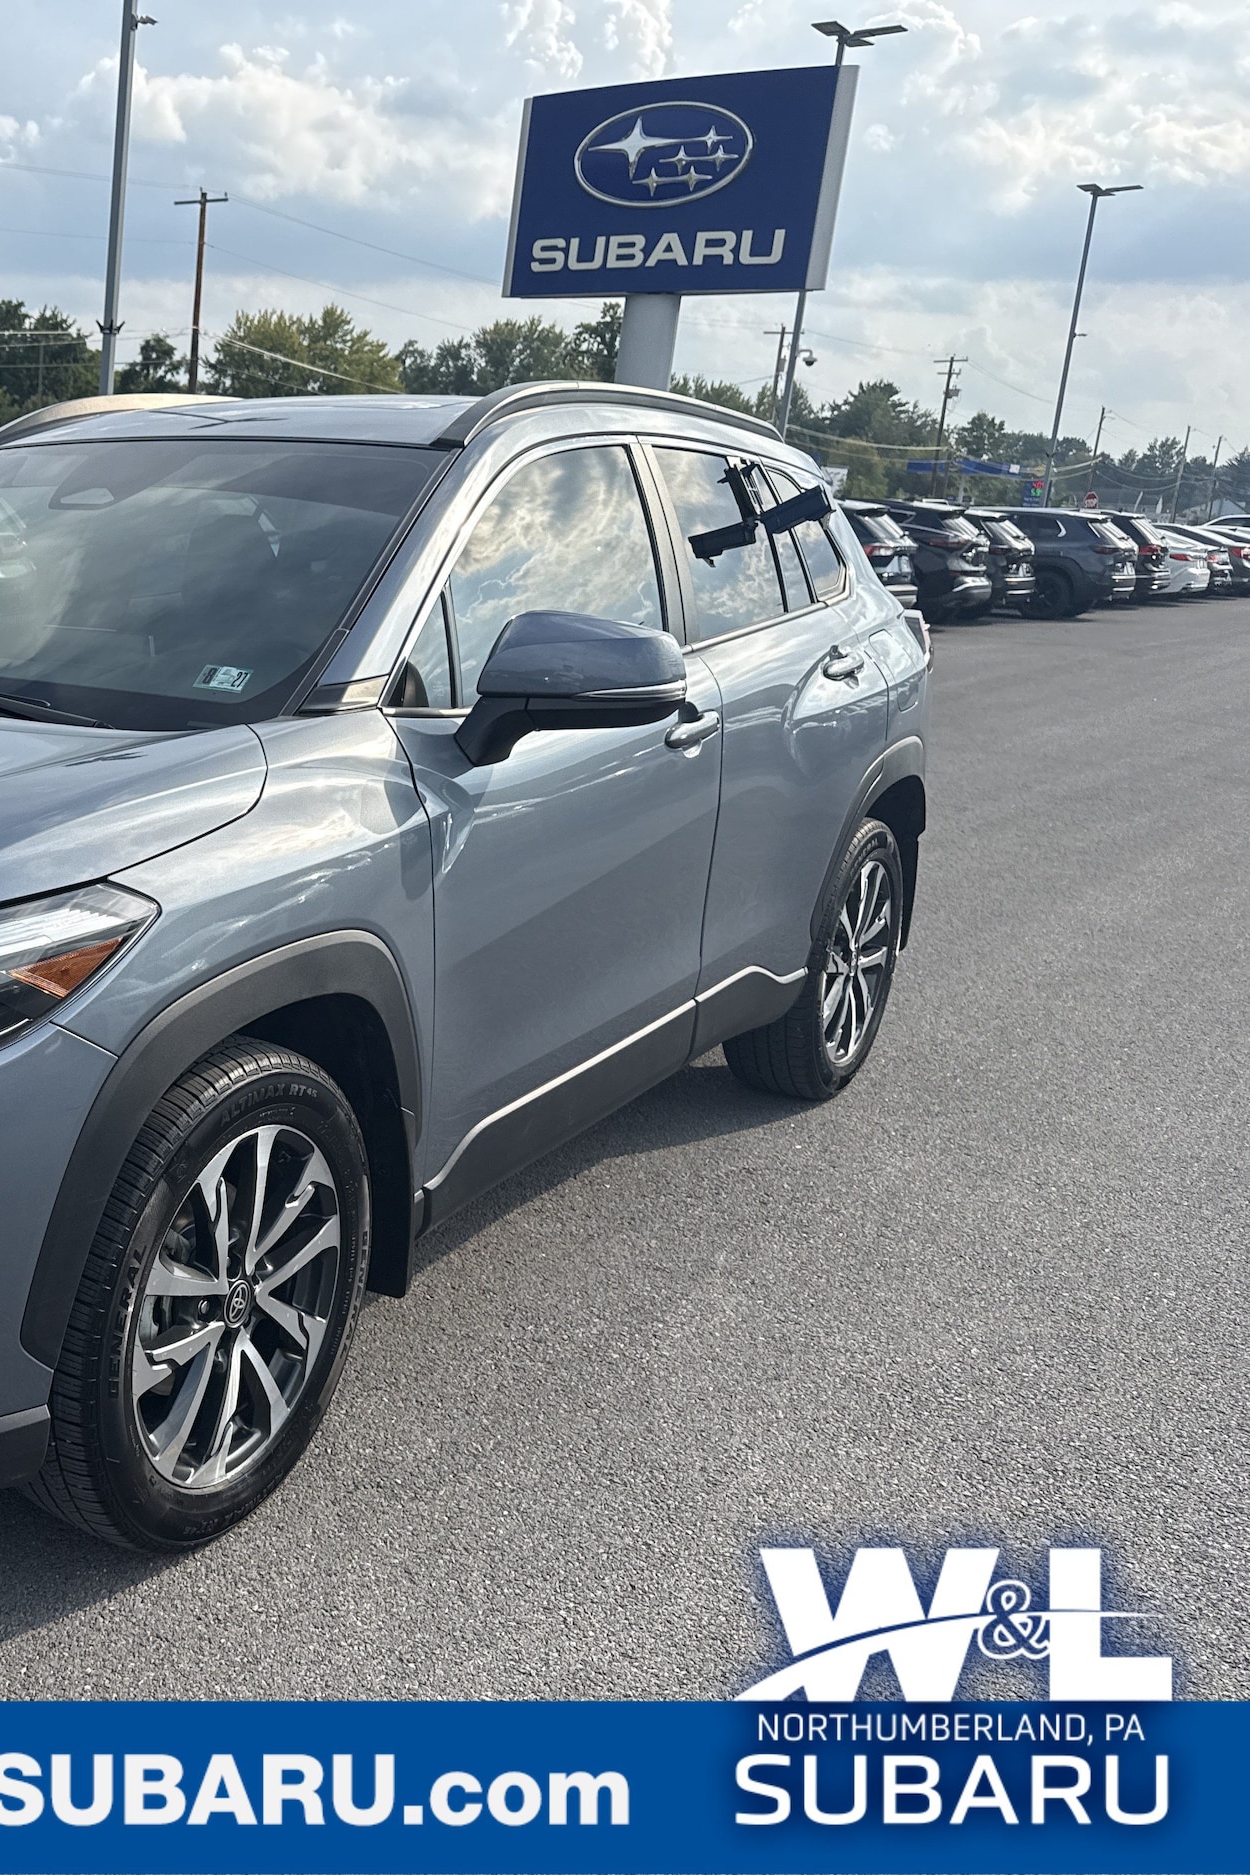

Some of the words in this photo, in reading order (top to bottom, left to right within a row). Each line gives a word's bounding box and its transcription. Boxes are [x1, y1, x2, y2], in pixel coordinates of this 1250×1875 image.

[530, 228, 786, 273] SUBARU
[230, 671, 249, 688] 27
[220, 1083, 286, 1127] ALTIMAX
[108, 1244, 147, 1399] GENERAL
